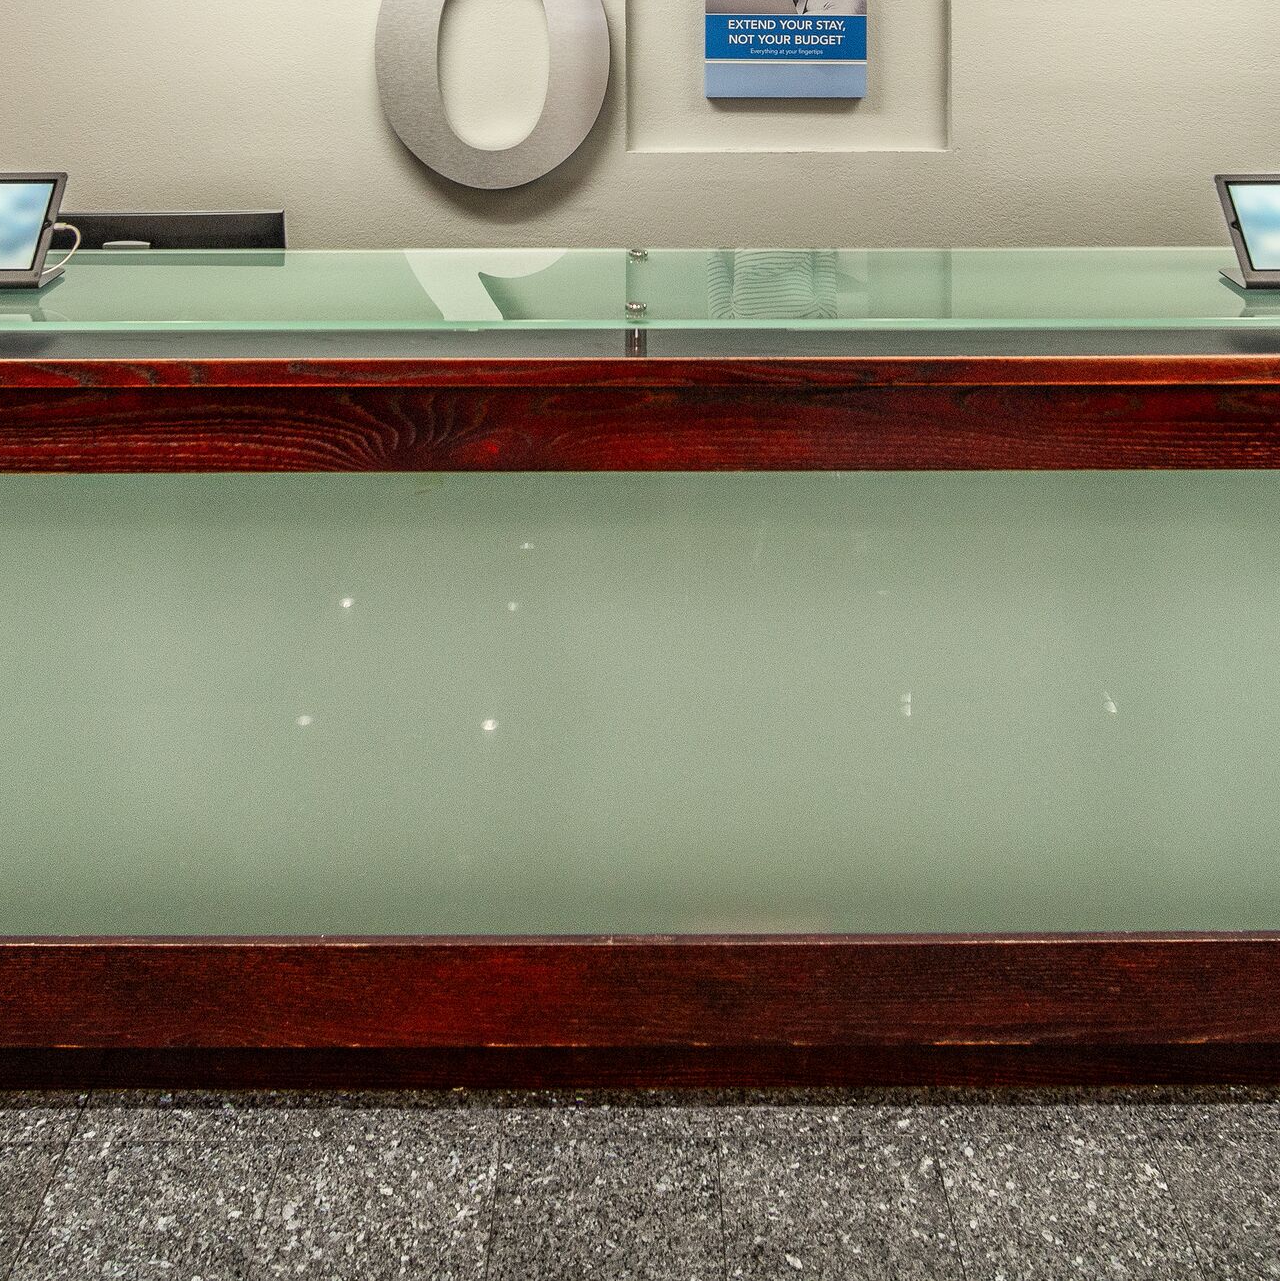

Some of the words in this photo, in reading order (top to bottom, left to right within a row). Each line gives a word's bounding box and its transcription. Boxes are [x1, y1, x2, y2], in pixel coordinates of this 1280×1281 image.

[728, 20, 776, 30] EXTEND
[780, 20, 812, 30] YOUR
[816, 20, 846, 32] STAY,
[728, 35, 754, 44] NOT
[758, 35, 791, 45] YOUR
[750, 48, 778, 56] Everything
[798, 48, 823, 56] fingertips
